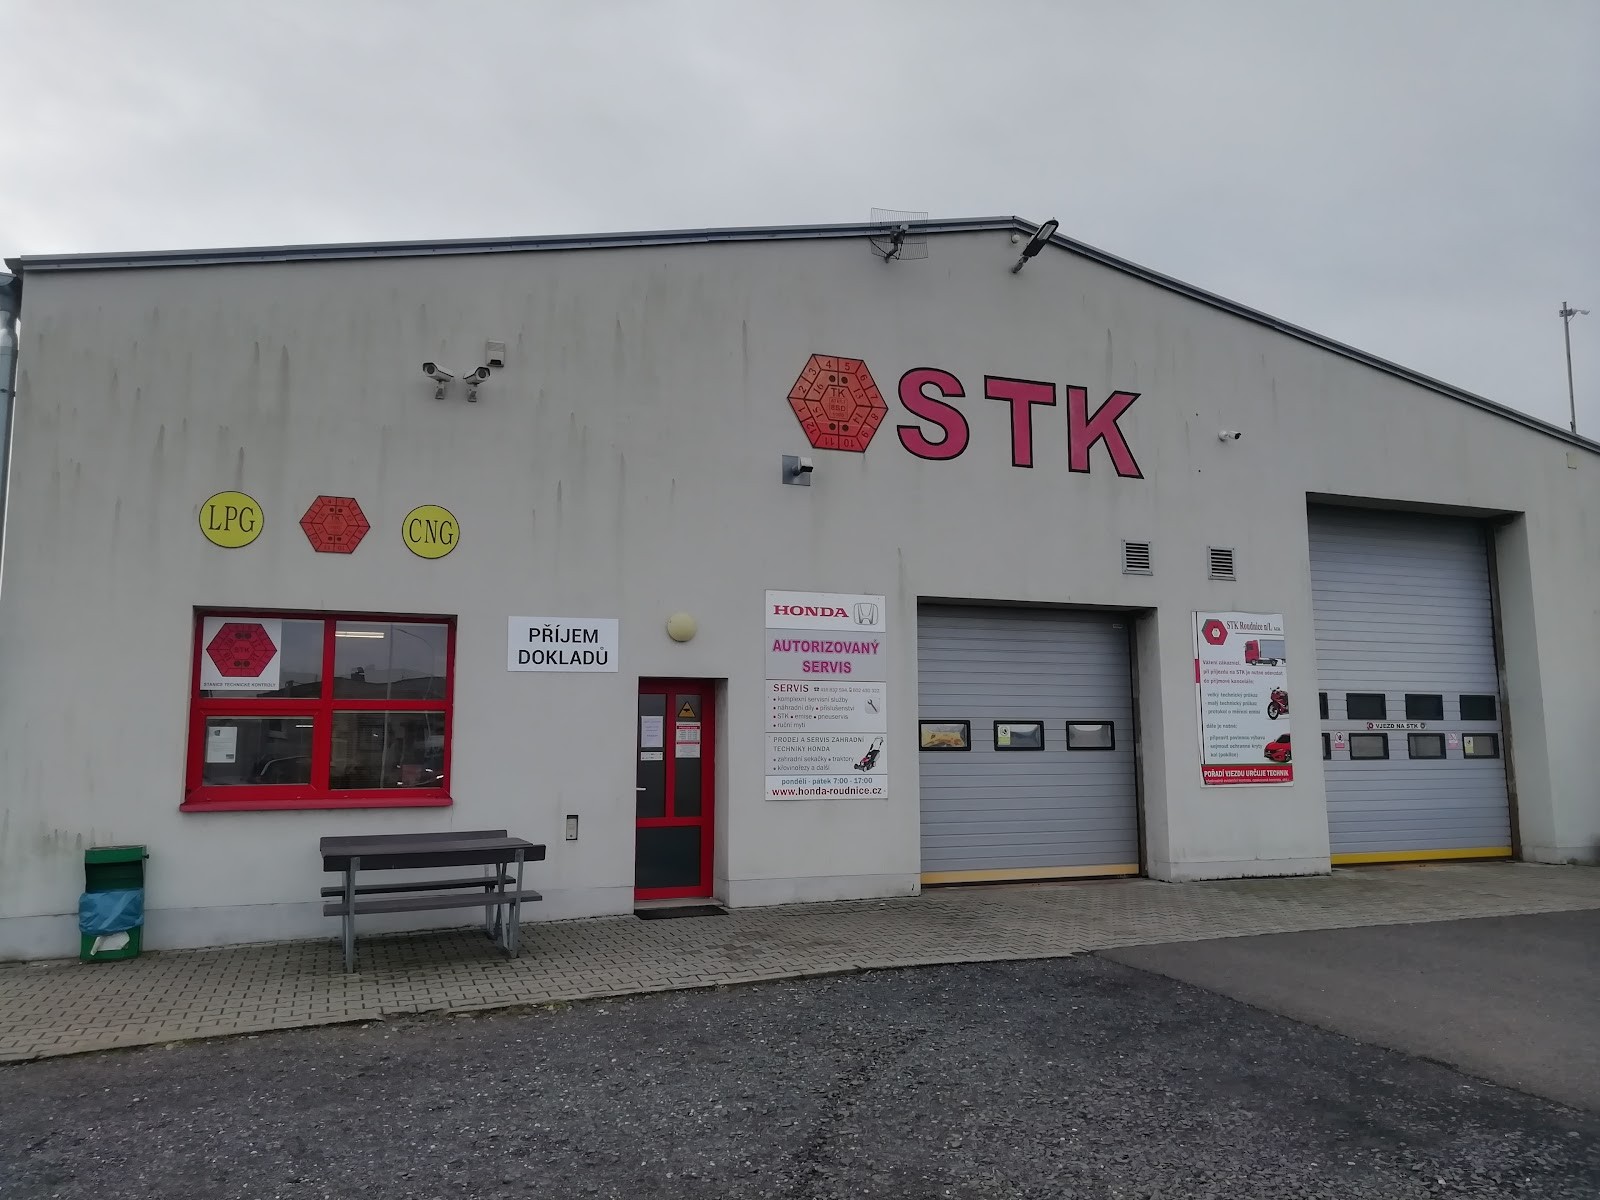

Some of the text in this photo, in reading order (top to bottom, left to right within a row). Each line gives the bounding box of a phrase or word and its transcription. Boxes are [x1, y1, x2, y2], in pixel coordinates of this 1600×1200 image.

[844, 362, 850, 370] 5
[830, 388, 846, 398] TK
[897, 366, 1144, 479] STK
[208, 504, 255, 532] LPG
[409, 518, 454, 545] CNG
[774, 605, 849, 618] HONDA
[1227, 621, 1238, 630] STK
[1240, 622, 1263, 631] Roudnice
[529, 624, 598, 643] PŘÍJEM
[773, 639, 880, 654] AUTORIZOVANÝ
[518, 646, 608, 665] DOKLADŮ
[802, 660, 852, 674] SERVIS
[773, 684, 809, 692] SERVIS
[1204, 769, 1224, 777] POŘADÍ
[772, 786, 882, 795] www.honda-roudnice.cz
